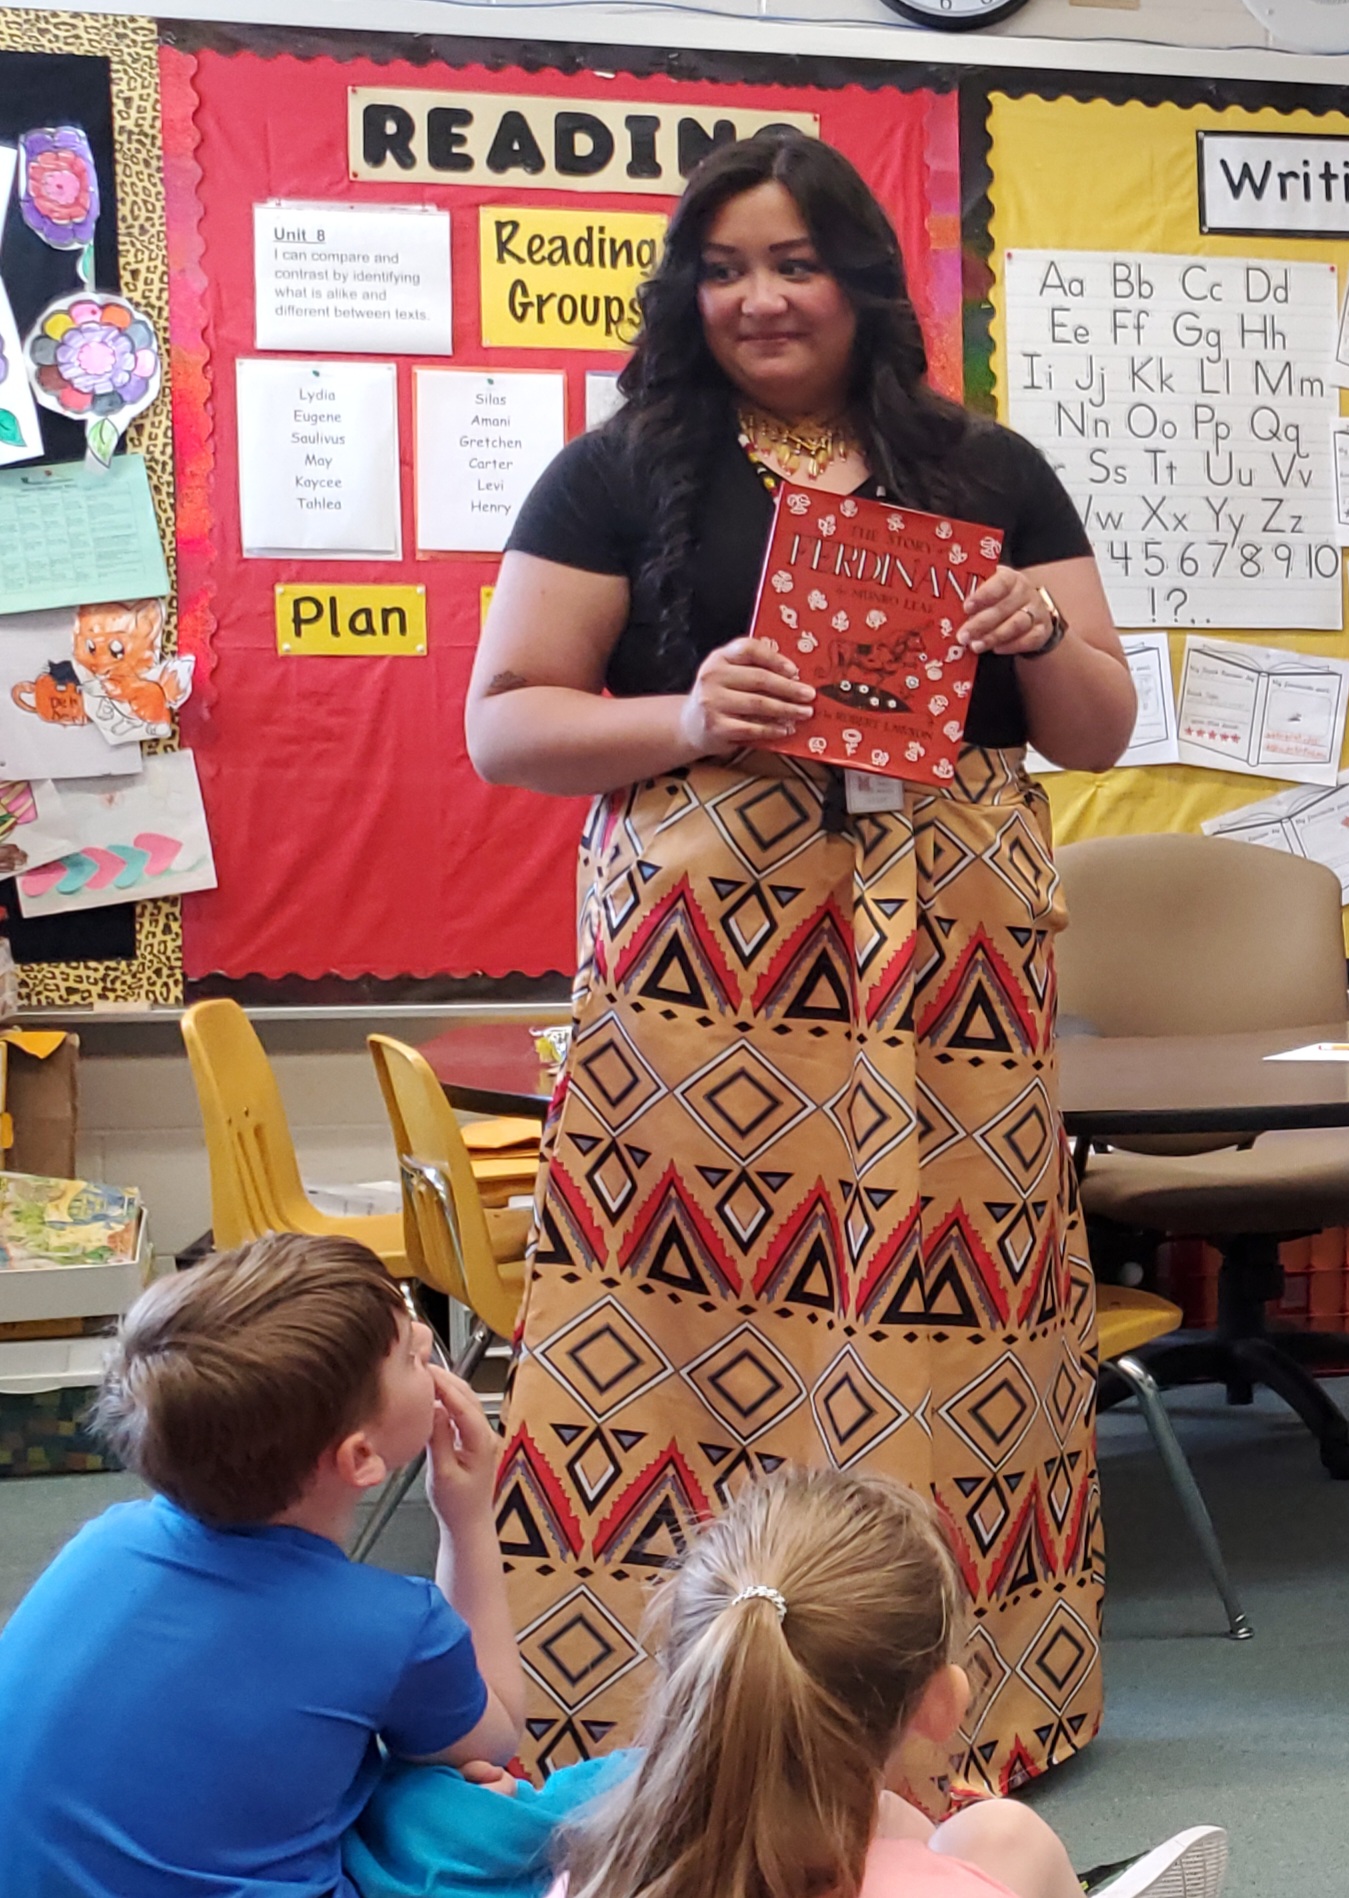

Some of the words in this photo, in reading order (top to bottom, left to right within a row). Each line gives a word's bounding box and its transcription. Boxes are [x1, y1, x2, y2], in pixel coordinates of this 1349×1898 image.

[362, 103, 806, 179] READIN
[274, 227, 307, 241] Unit
[316, 229, 326, 242] 8
[495, 219, 657, 270] Reading
[282, 251, 307, 261] can
[311, 251, 370, 264] compare
[374, 252, 399, 264] and
[274, 268, 329, 281] contrast
[333, 269, 349, 284] by
[353, 270, 421, 286] identifying
[1039, 261, 1085, 297] Aa
[1112, 263, 1154, 299] Bb
[1181, 265, 1222, 301] Cc
[1245, 267, 1289, 304] Dd
[274, 286, 308, 299] what
[311, 287, 322, 299] is
[327, 287, 358, 300] alike
[362, 289, 388, 301] and
[275, 305, 330, 318] different
[334, 306, 391, 319] between
[508, 278, 645, 337] Groups
[1051, 308, 1090, 344] Ee
[1112, 309, 1149, 345] Ff
[1173, 312, 1222, 363] Gg
[1241, 313, 1287, 350] Hh
[1022, 353, 1054, 389] Ii
[1075, 354, 1106, 407] Jj
[1131, 356, 1175, 393] Kk
[1200, 358, 1230, 395] Ll
[1254, 359, 1324, 397] Mm
[299, 388, 336, 403] Lydia
[475, 393, 507, 406] Silas
[293, 410, 342, 425] Eugene
[470, 415, 511, 428] Amani
[1057, 401, 1110, 438] Nn
[1127, 403, 1178, 440] Oo
[1193, 404, 1231, 456] Pp
[1250, 406, 1309, 459] Qq
[459, 435, 522, 449] Gretchen
[304, 454, 333, 469] May
[469, 457, 513, 471] Carter
[1089, 449, 1127, 485] Ss
[1144, 450, 1177, 485] Tt
[1206, 451, 1252, 487] Uu
[1271, 451, 1312, 488] Vv
[295, 474, 343, 490] Kaycee
[477, 478, 504, 492] Levi
[297, 497, 342, 510] Tahlea
[470, 500, 511, 515] Henry
[1141, 496, 1188, 532] Xx
[1205, 497, 1244, 548] Yy
[1261, 497, 1304, 533] Zz
[291, 596, 407, 638] Plan
